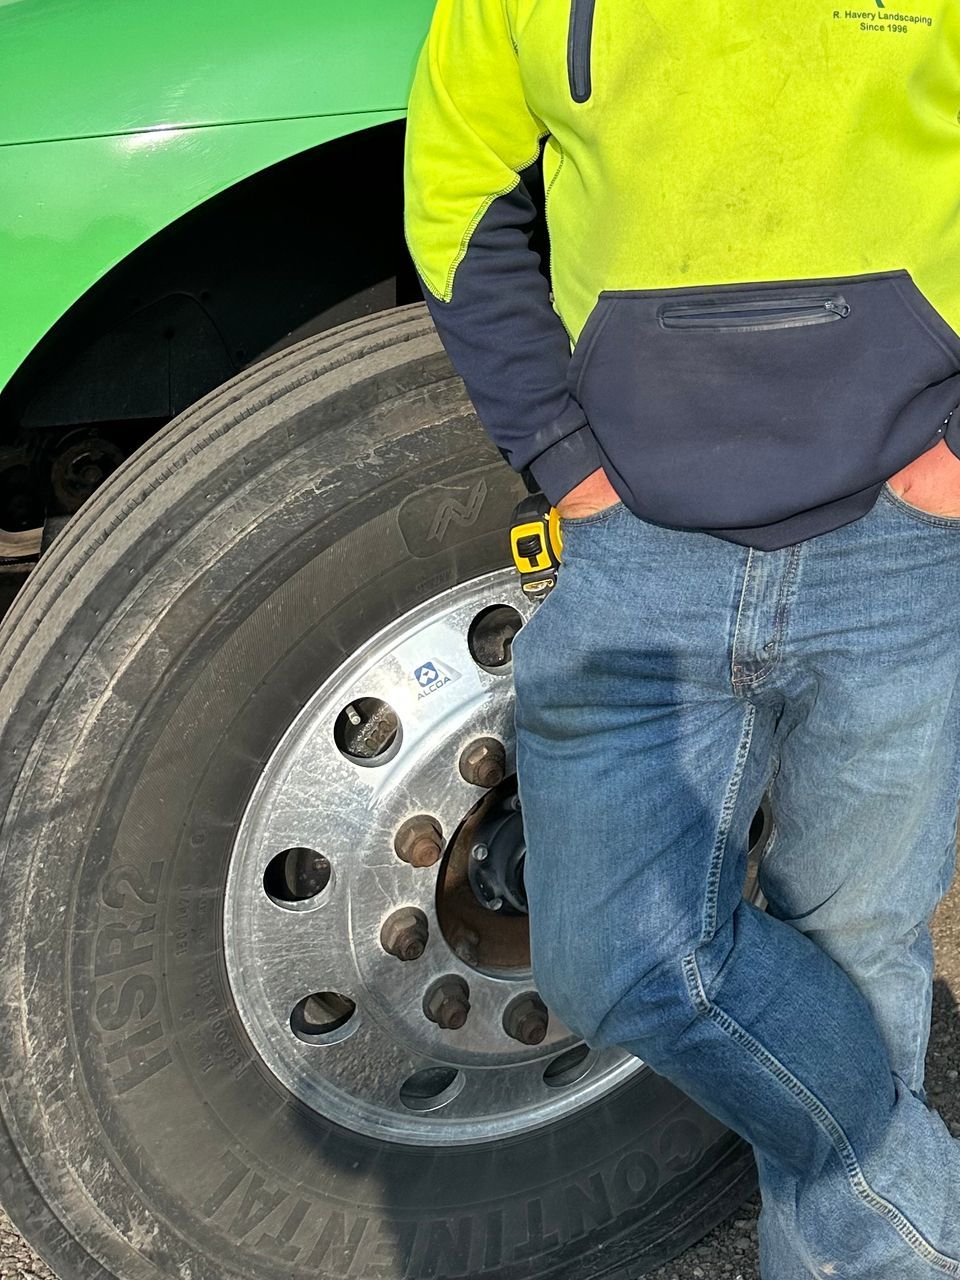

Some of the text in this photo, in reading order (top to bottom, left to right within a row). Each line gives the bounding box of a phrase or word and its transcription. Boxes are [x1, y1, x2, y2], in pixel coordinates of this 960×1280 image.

[845, 11, 876, 21] Havery
[878, 11, 933, 26] Landscaping
[860, 23, 908, 34] Since 1996
[417, 676, 452, 701] ALCOA
[94, 861, 172, 1095] HSR2
